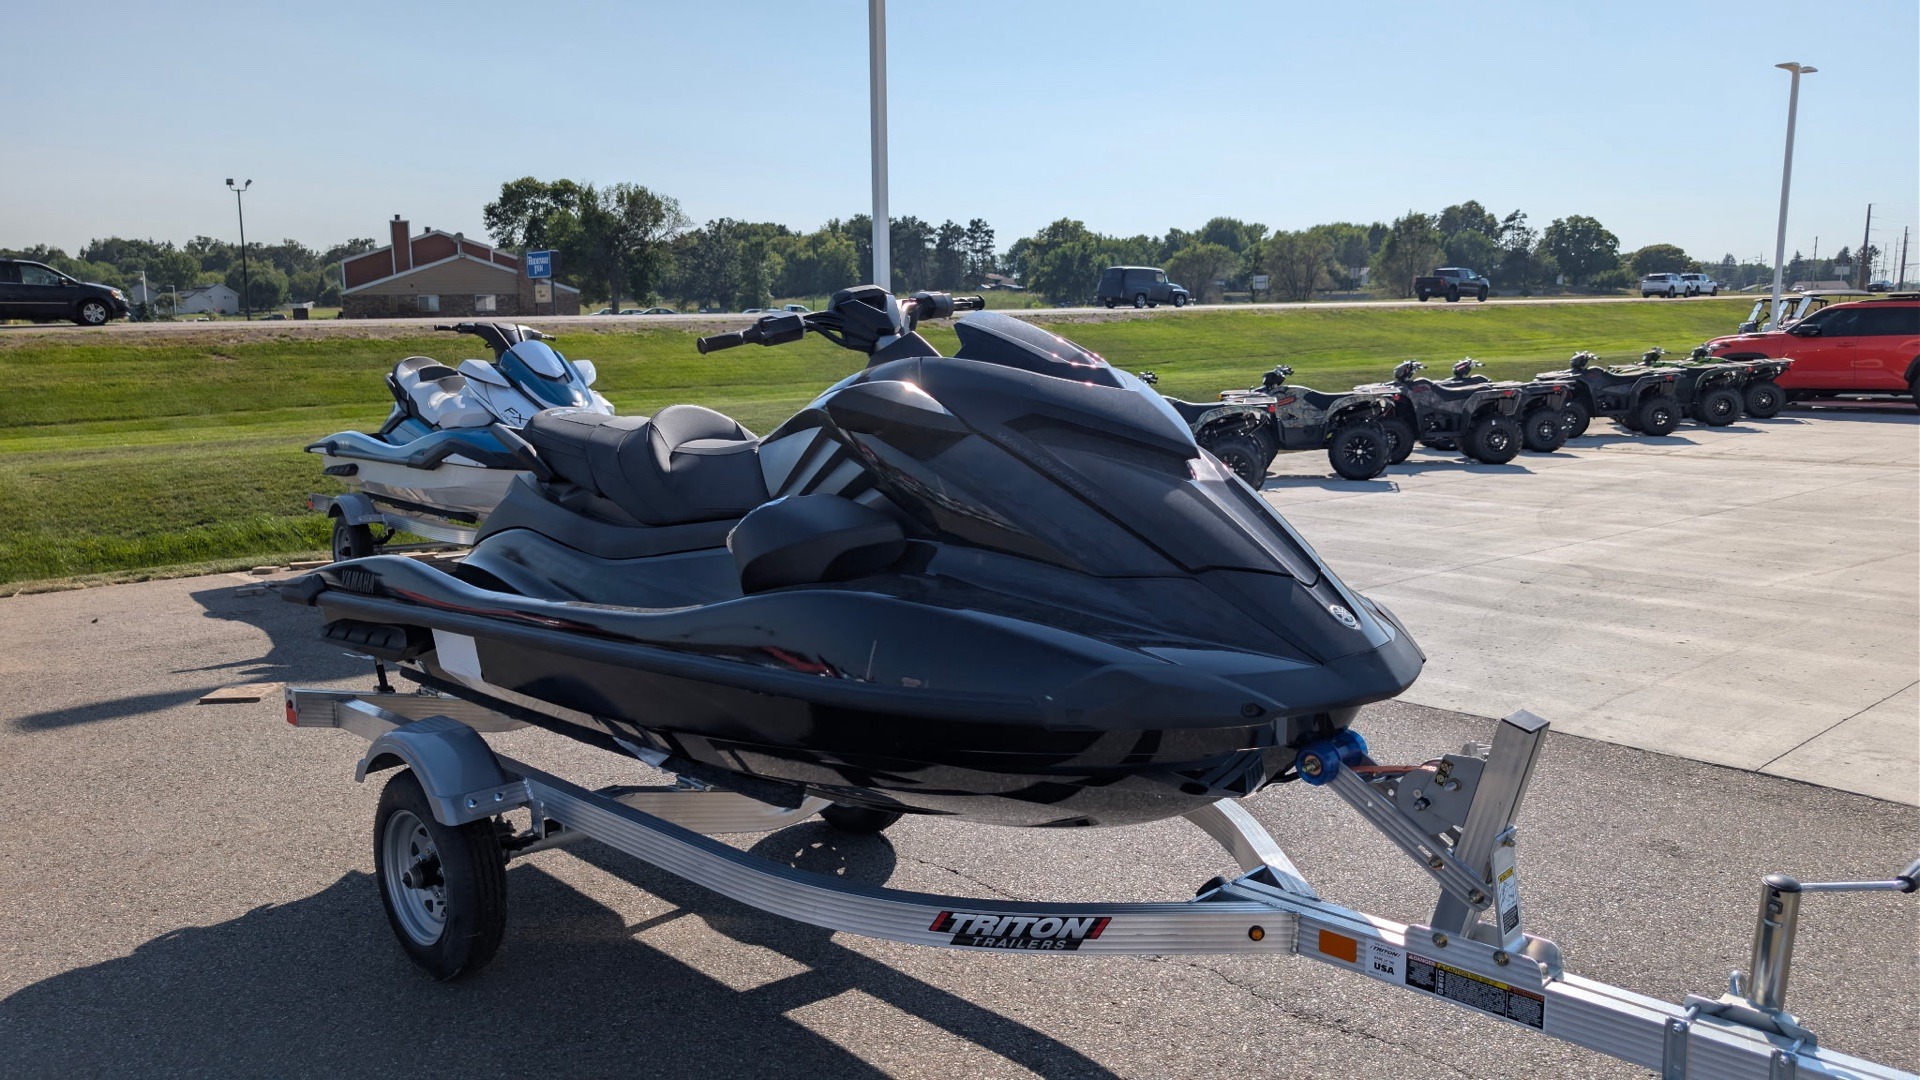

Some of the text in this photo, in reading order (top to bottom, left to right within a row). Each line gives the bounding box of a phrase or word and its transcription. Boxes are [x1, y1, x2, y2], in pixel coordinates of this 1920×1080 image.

[504, 407, 529, 424] FX
[342, 569, 375, 594] YAMAHA
[949, 912, 1096, 939] TRITON
[972, 936, 1067, 950] TRAILERS
[1372, 945, 1399, 957] TRITON
[1373, 961, 1395, 975] USA
[1413, 955, 1436, 967] DANGER
